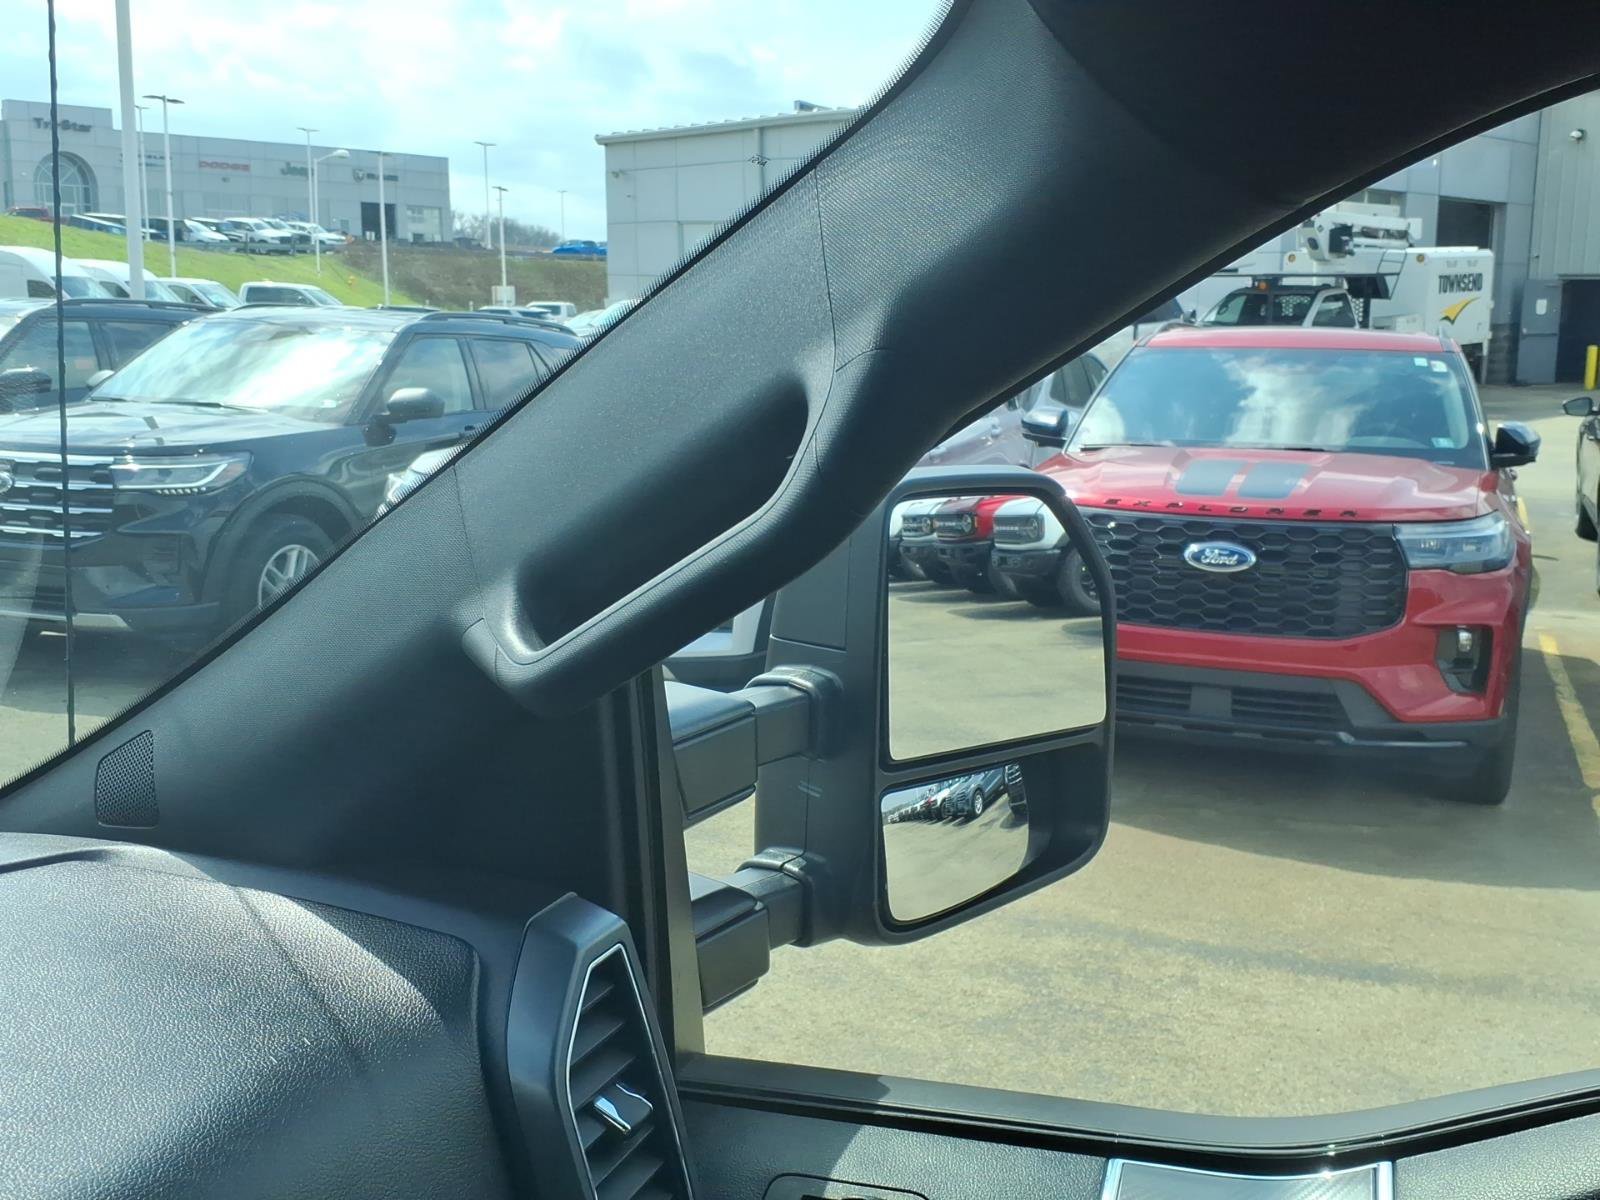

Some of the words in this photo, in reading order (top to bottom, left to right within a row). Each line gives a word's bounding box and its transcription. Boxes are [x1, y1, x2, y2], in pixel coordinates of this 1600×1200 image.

[32, 117, 92, 133] Tr-Star
[199, 161, 250, 172] DODGE
[1438, 272, 1483, 294] TOWNSEND
[1104, 498, 1358, 518] EXPLORER
[1200, 548, 1238, 566] Ford
